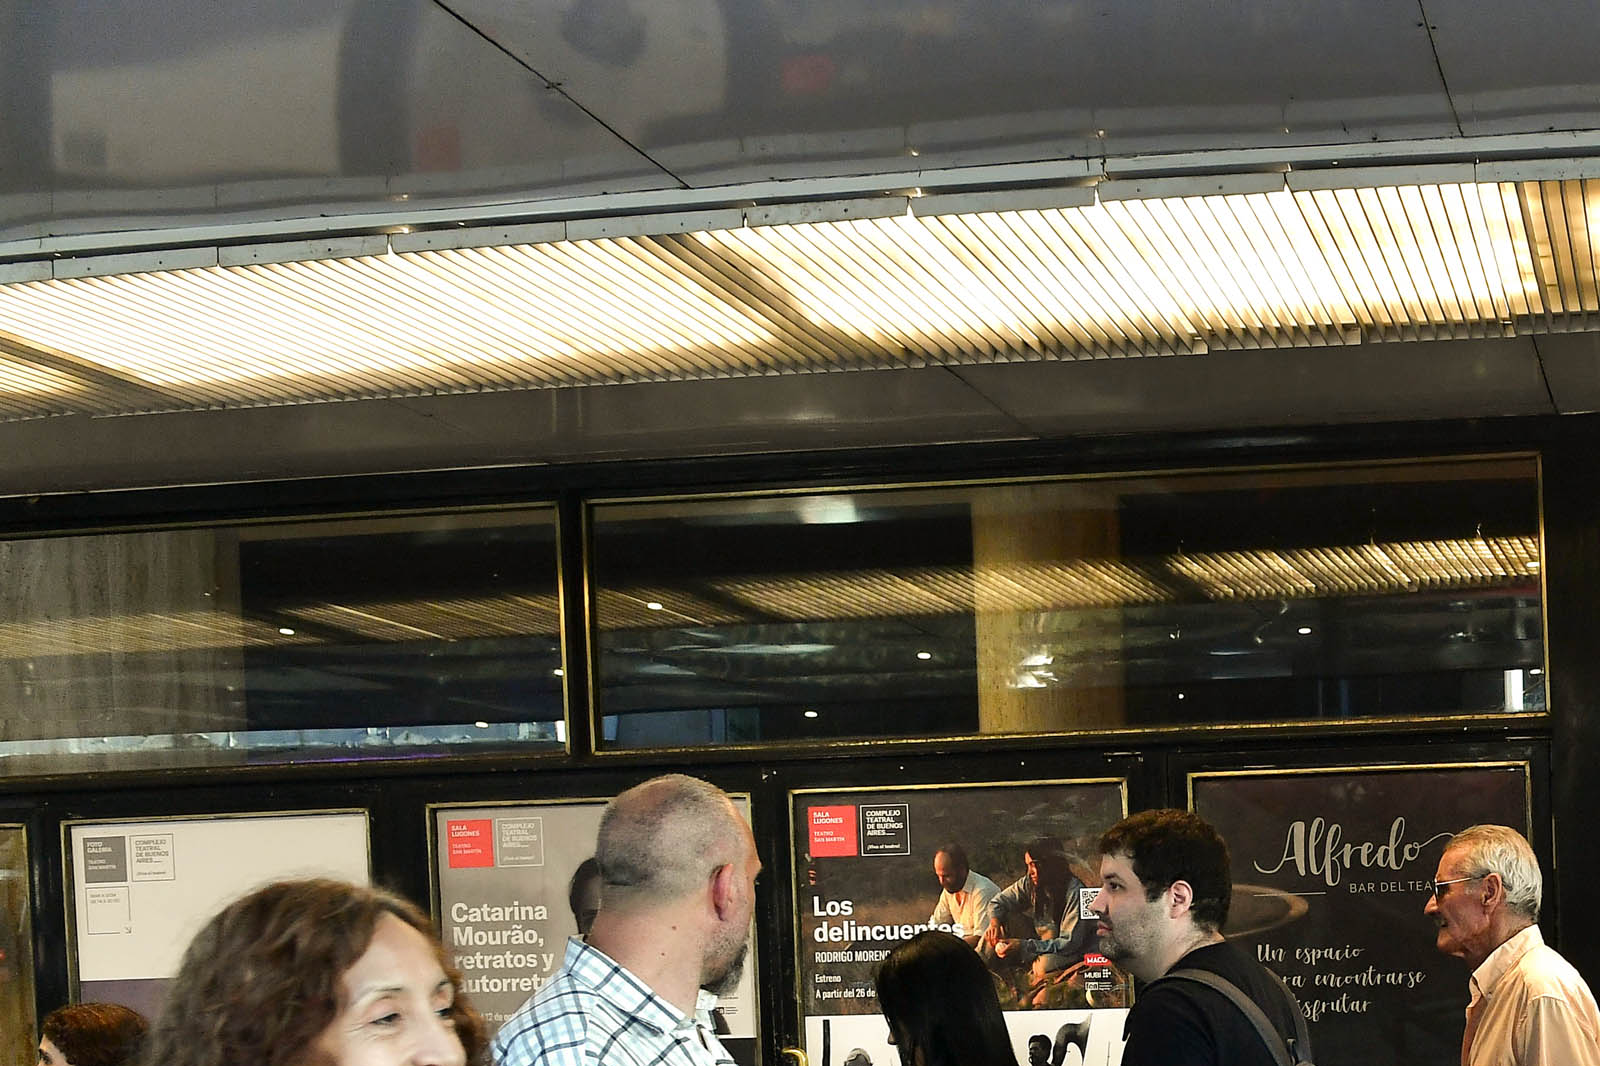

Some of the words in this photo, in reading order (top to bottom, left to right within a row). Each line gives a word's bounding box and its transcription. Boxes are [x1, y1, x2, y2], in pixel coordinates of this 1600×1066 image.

[1254, 817, 1455, 886] Alfredo
[1350, 883, 1375, 893] BAR
[1381, 882, 1405, 892] DEL
[1408, 881, 1435, 891] TEA
[451, 901, 548, 923] Catarina
[813, 896, 853, 916] Los
[453, 924, 544, 947] Mourão,
[454, 951, 538, 970] retratos
[542, 953, 554, 972] y
[815, 952, 853, 963] RODRIGO
[1257, 944, 1286, 962] Un
[1296, 945, 1365, 965] espacio
[815, 974, 842, 983] Estreno
[1315, 966, 1426, 988] encontrarse
[815, 990, 821, 999] A
[822, 988, 843, 1000] partir
[843, 988, 855, 998] del
[855, 988, 866, 998] 26
[866, 988, 876, 998] de
